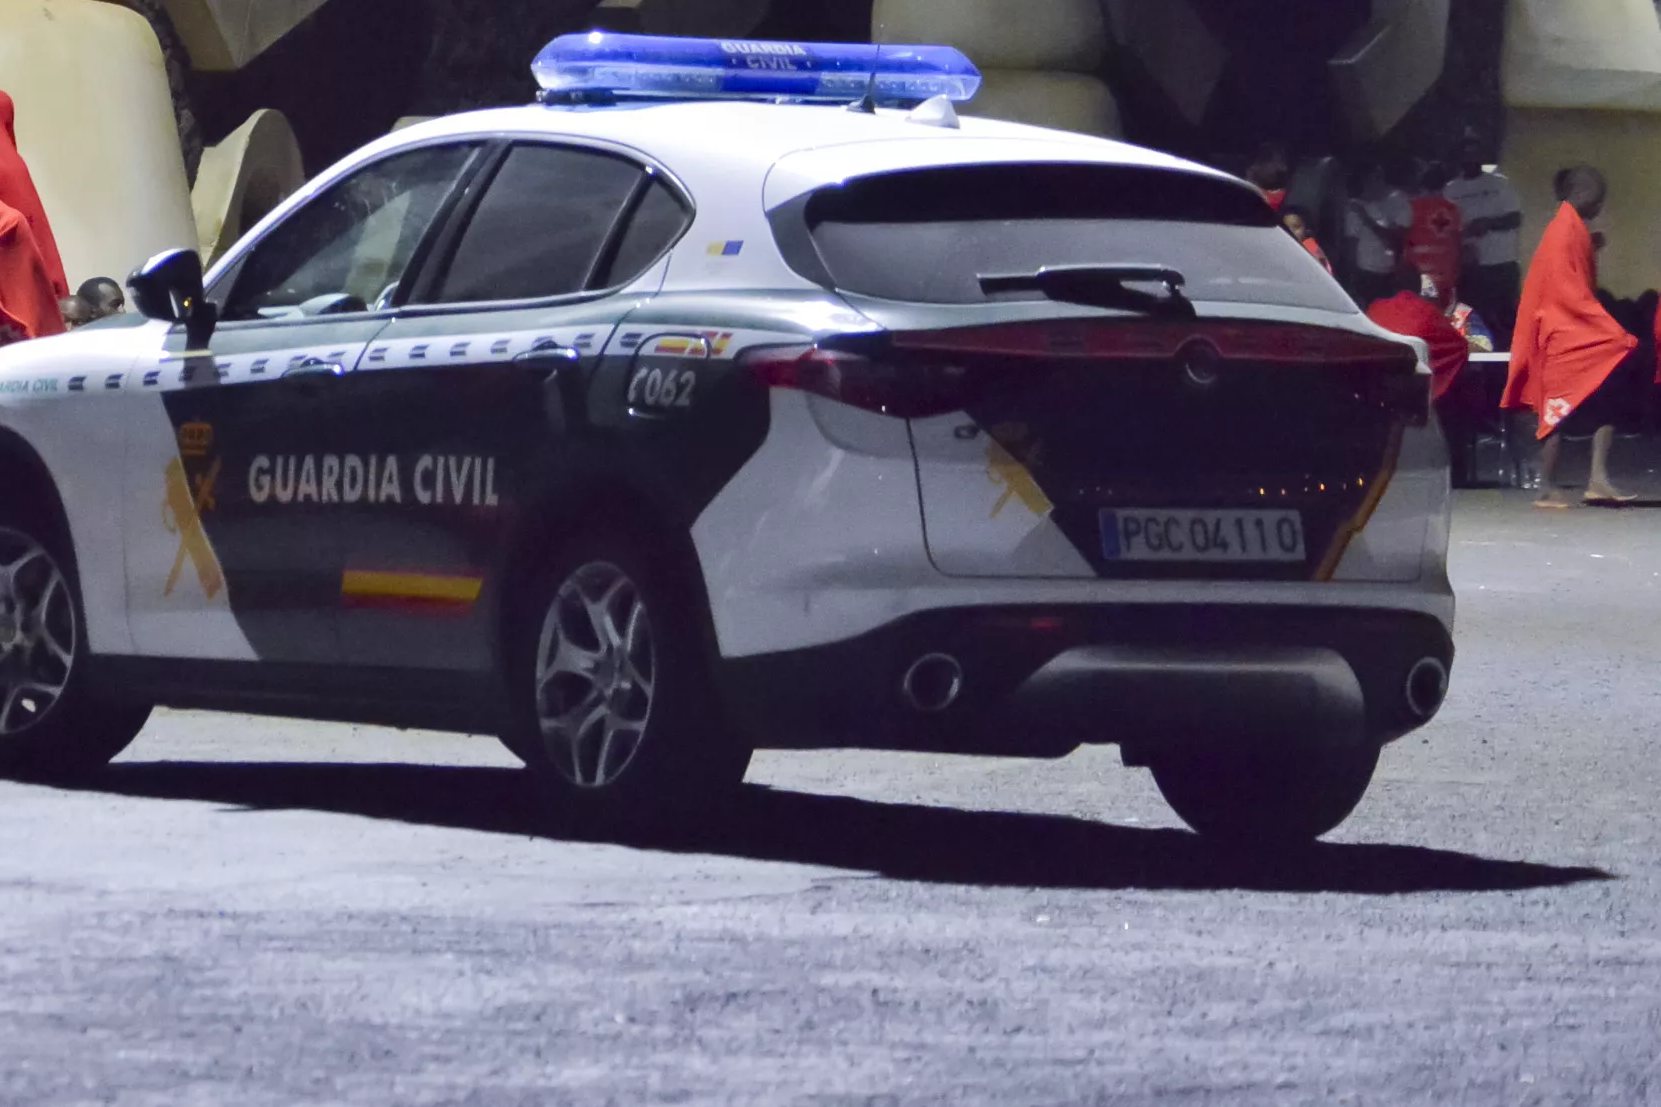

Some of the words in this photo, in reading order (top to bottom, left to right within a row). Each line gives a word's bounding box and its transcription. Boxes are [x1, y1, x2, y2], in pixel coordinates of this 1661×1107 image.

[720, 42, 807, 56] GUARDIA
[745, 55, 798, 71] CIVIL
[32, 378, 58, 392] CIVIL
[644, 367, 696, 407] 062
[248, 453, 402, 504] GUARDIA
[413, 453, 499, 506] CIVIL
